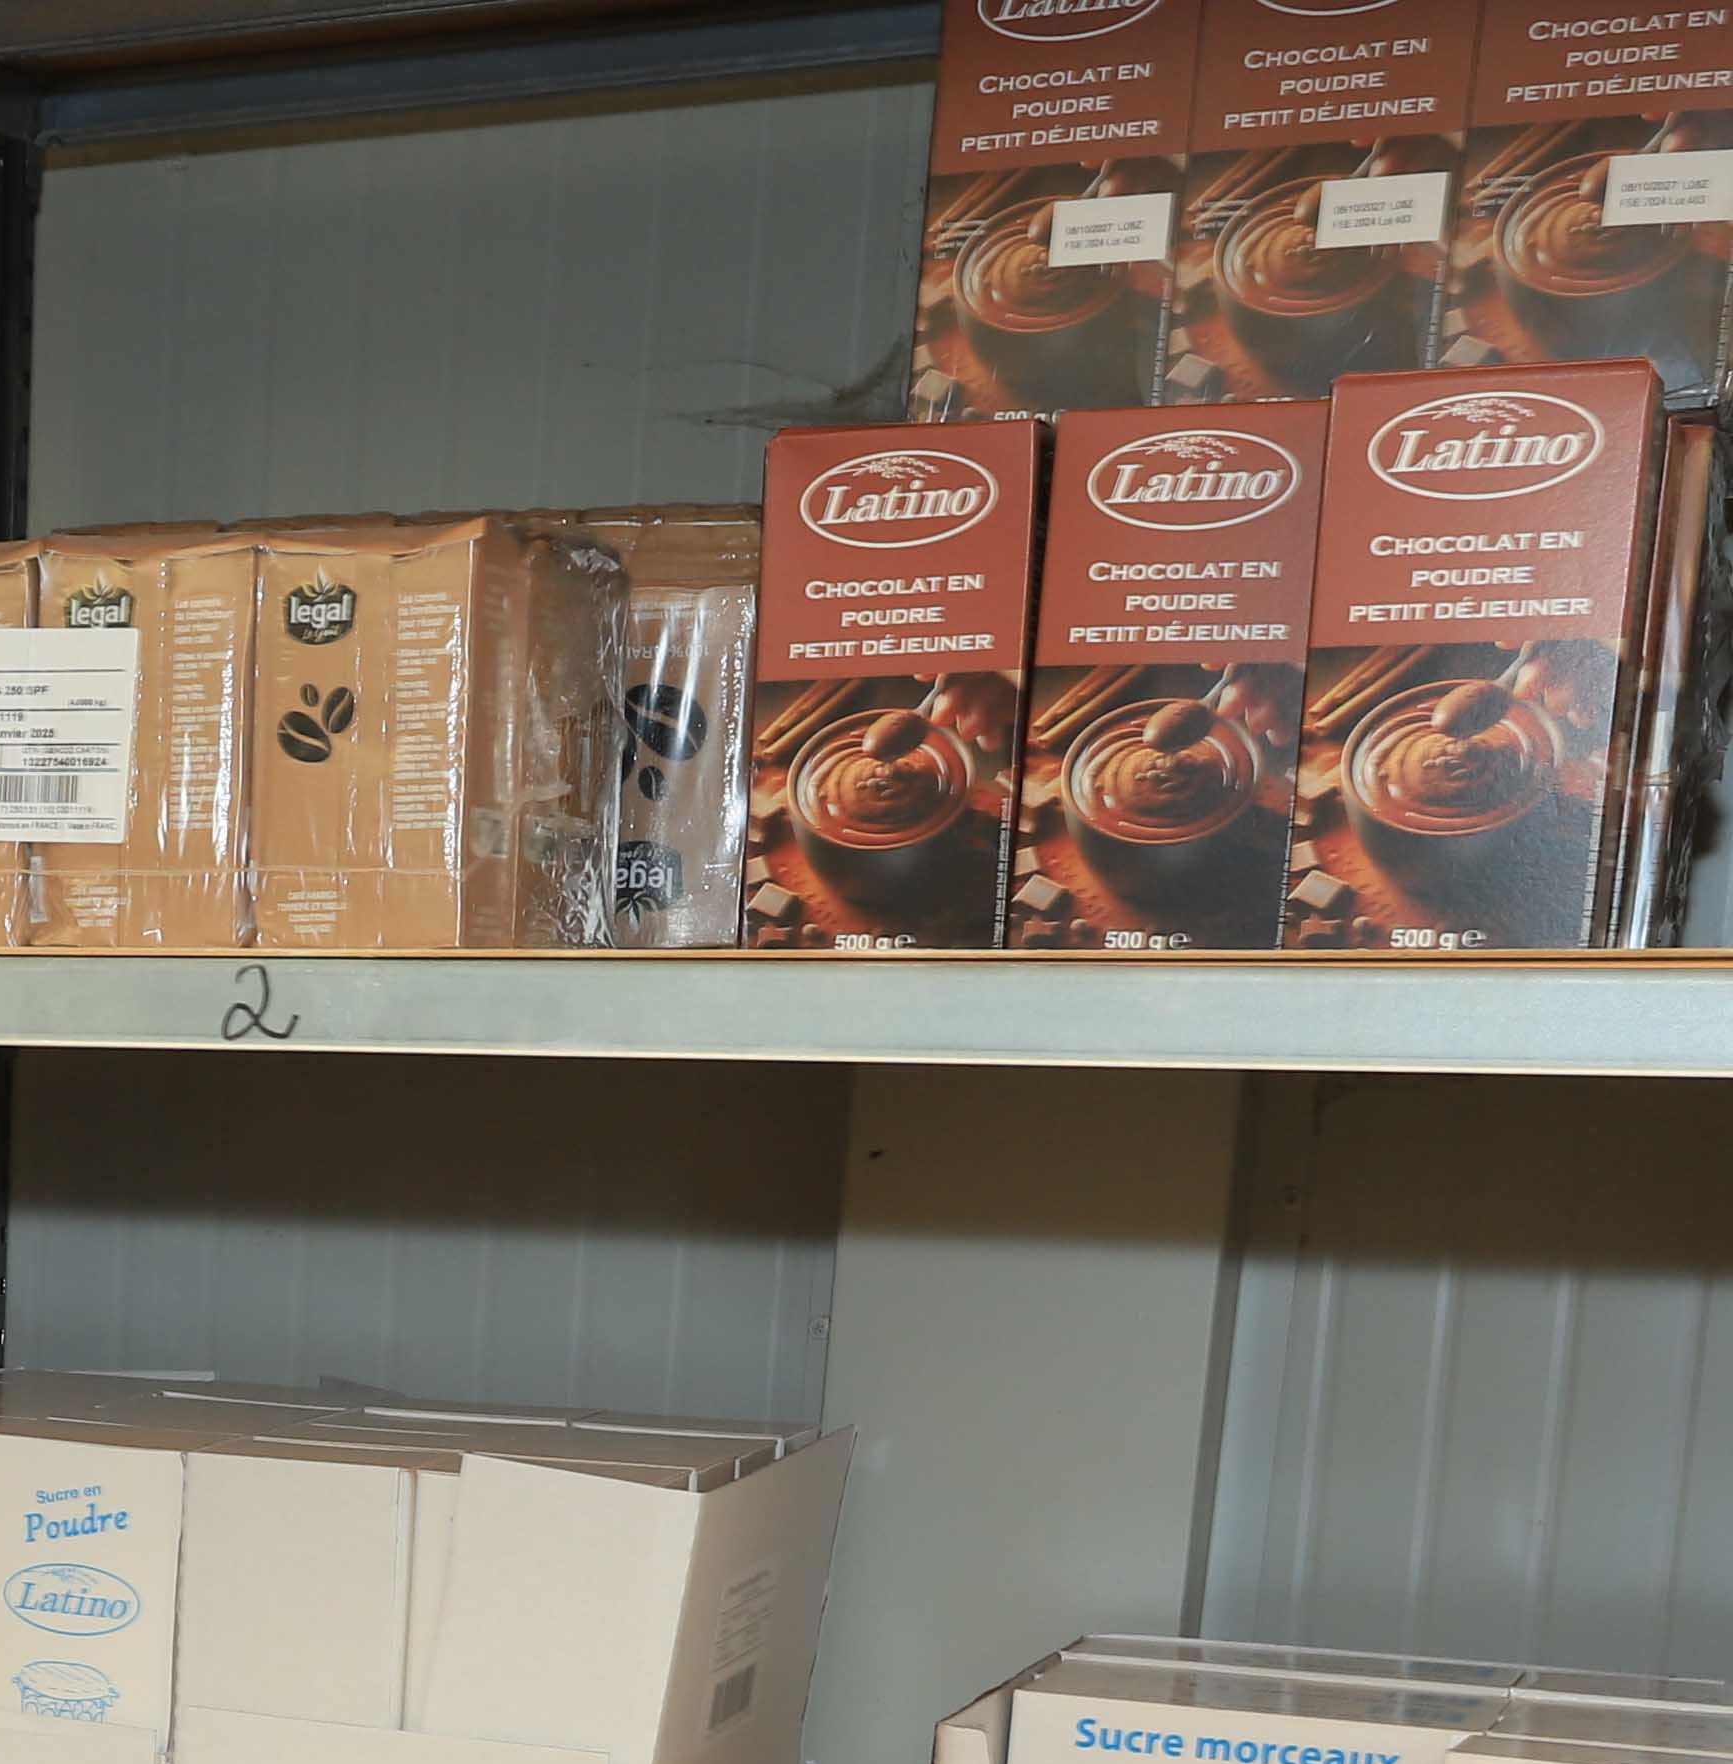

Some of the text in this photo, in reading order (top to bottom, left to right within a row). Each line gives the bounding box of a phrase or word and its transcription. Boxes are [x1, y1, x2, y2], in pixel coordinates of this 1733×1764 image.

[1688, 9, 1725, 28] EN
[1392, 38, 1428, 55] EN
[1565, 44, 1679, 68] POUDRE
[1117, 63, 1152, 80] EN
[1280, 72, 1385, 96] POUDRE
[1506, 70, 1733, 103] PETIT DÉJEUNER
[1013, 96, 1112, 119] POUDRE
[1224, 97, 1435, 129] PETIT DÉJEUNER
[961, 120, 1159, 152] PETIT DÉJEUNER
[1386, 424, 1583, 472] Latino
[1104, 460, 1280, 504] Latino
[817, 480, 979, 525] Latino
[1539, 531, 1582, 550] EN
[1242, 561, 1279, 578] EN
[1411, 566, 1534, 587] POUDRE
[948, 575, 981, 590] EN
[70, 596, 129, 628] legal
[289, 595, 350, 630] legal
[1125, 593, 1237, 611] POUDRE
[1348, 597, 1591, 622] PETIT DÉJEUNER
[841, 607, 945, 627] POUDRE
[1069, 621, 1288, 643] PETIT DÉJEUNER
[789, 634, 993, 659] PETIT DÉJEUNER
[616, 859, 673, 898] lega
[834, 934, 874, 949] 500
[1104, 929, 1142, 948] 500
[1391, 928, 1433, 948] 500
[221, 964, 299, 1041] 2
[36, 1484, 102, 1505] Sucre en
[24, 1503, 129, 1543] Poudre
[14, 1581, 130, 1620] Latino
[1075, 1718, 1183, 1757] Sucre
